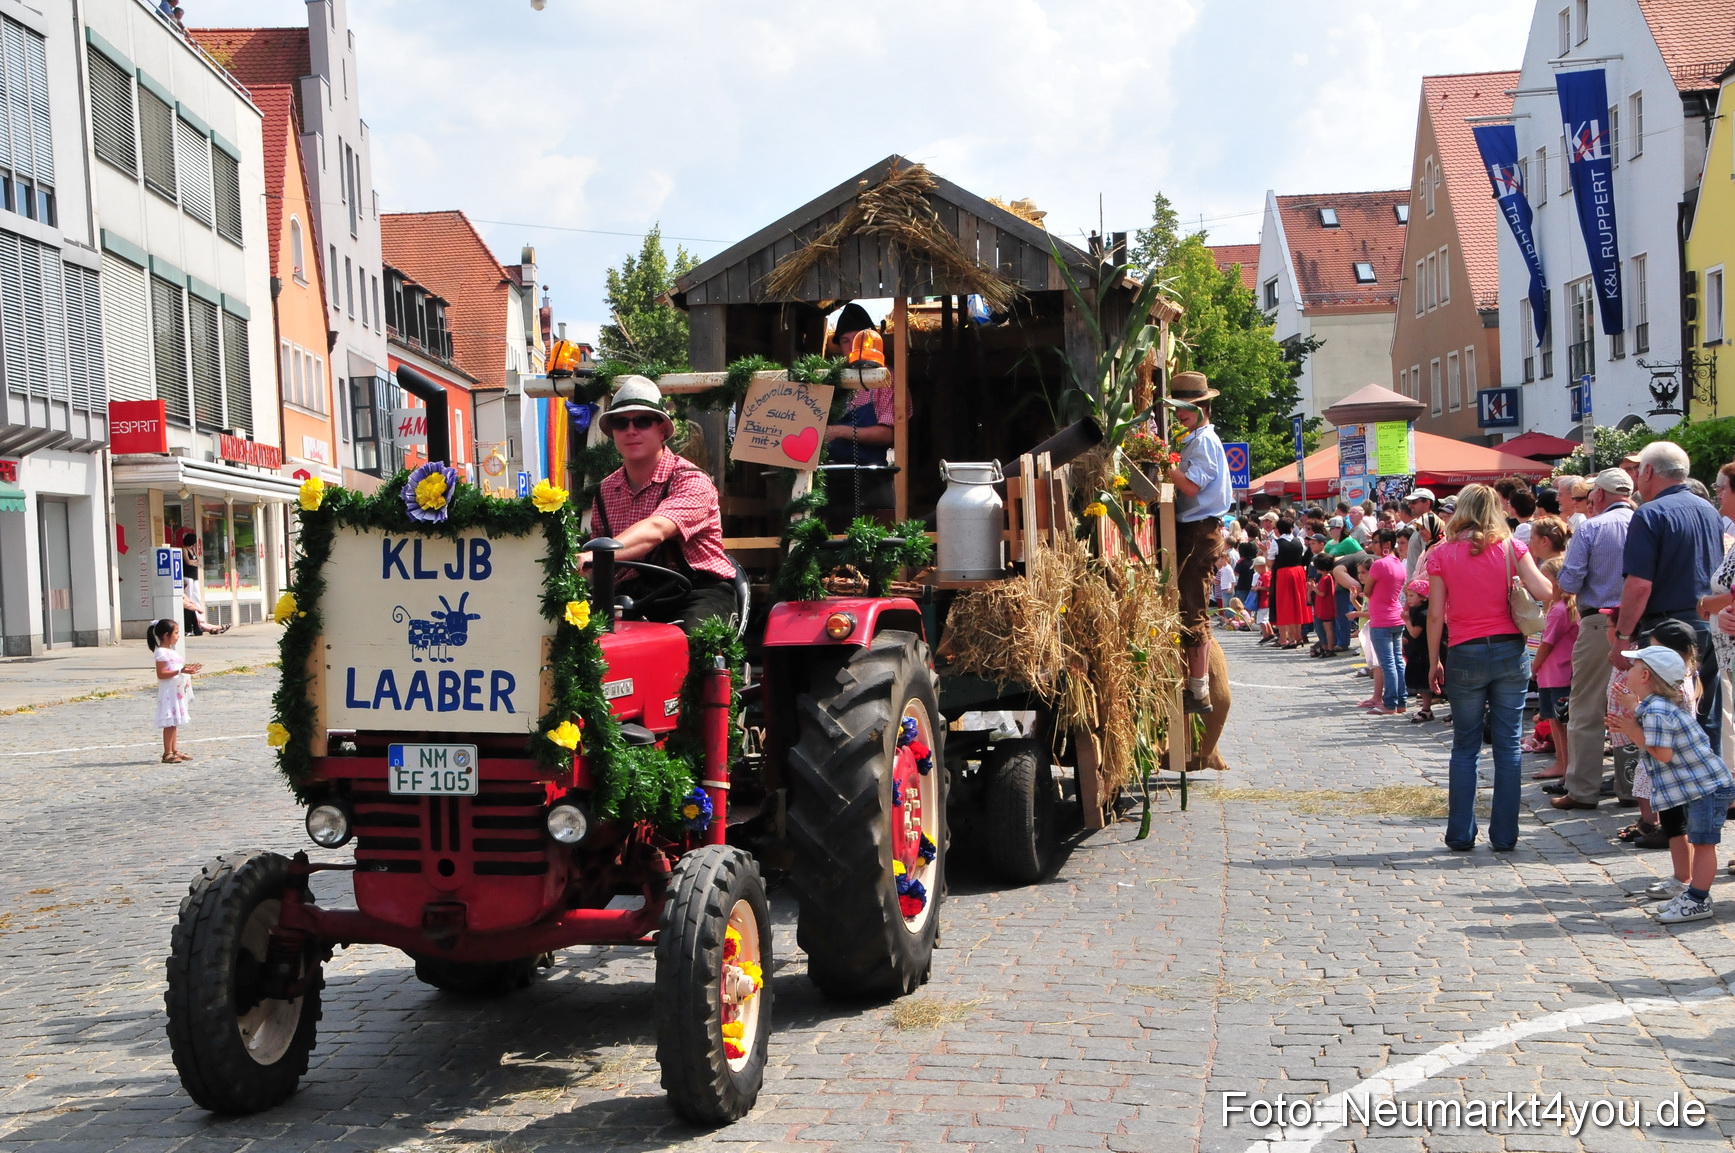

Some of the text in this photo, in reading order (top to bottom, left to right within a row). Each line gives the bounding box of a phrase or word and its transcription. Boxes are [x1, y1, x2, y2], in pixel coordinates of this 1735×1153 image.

[1591, 169, 1618, 299] K&L RUPPERT
[111, 420, 159, 434] ESPRIT
[398, 416, 427, 437] H&M
[751, 436, 770, 446] mit
[519, 476, 525, 497] P
[1231, 475, 1246, 485] AXI
[159, 552, 168, 566] P
[175, 561, 180, 578] P
[346, 667, 516, 714] LAABER
[420, 748, 447, 768] NM
[398, 771, 470, 791] FF 105
